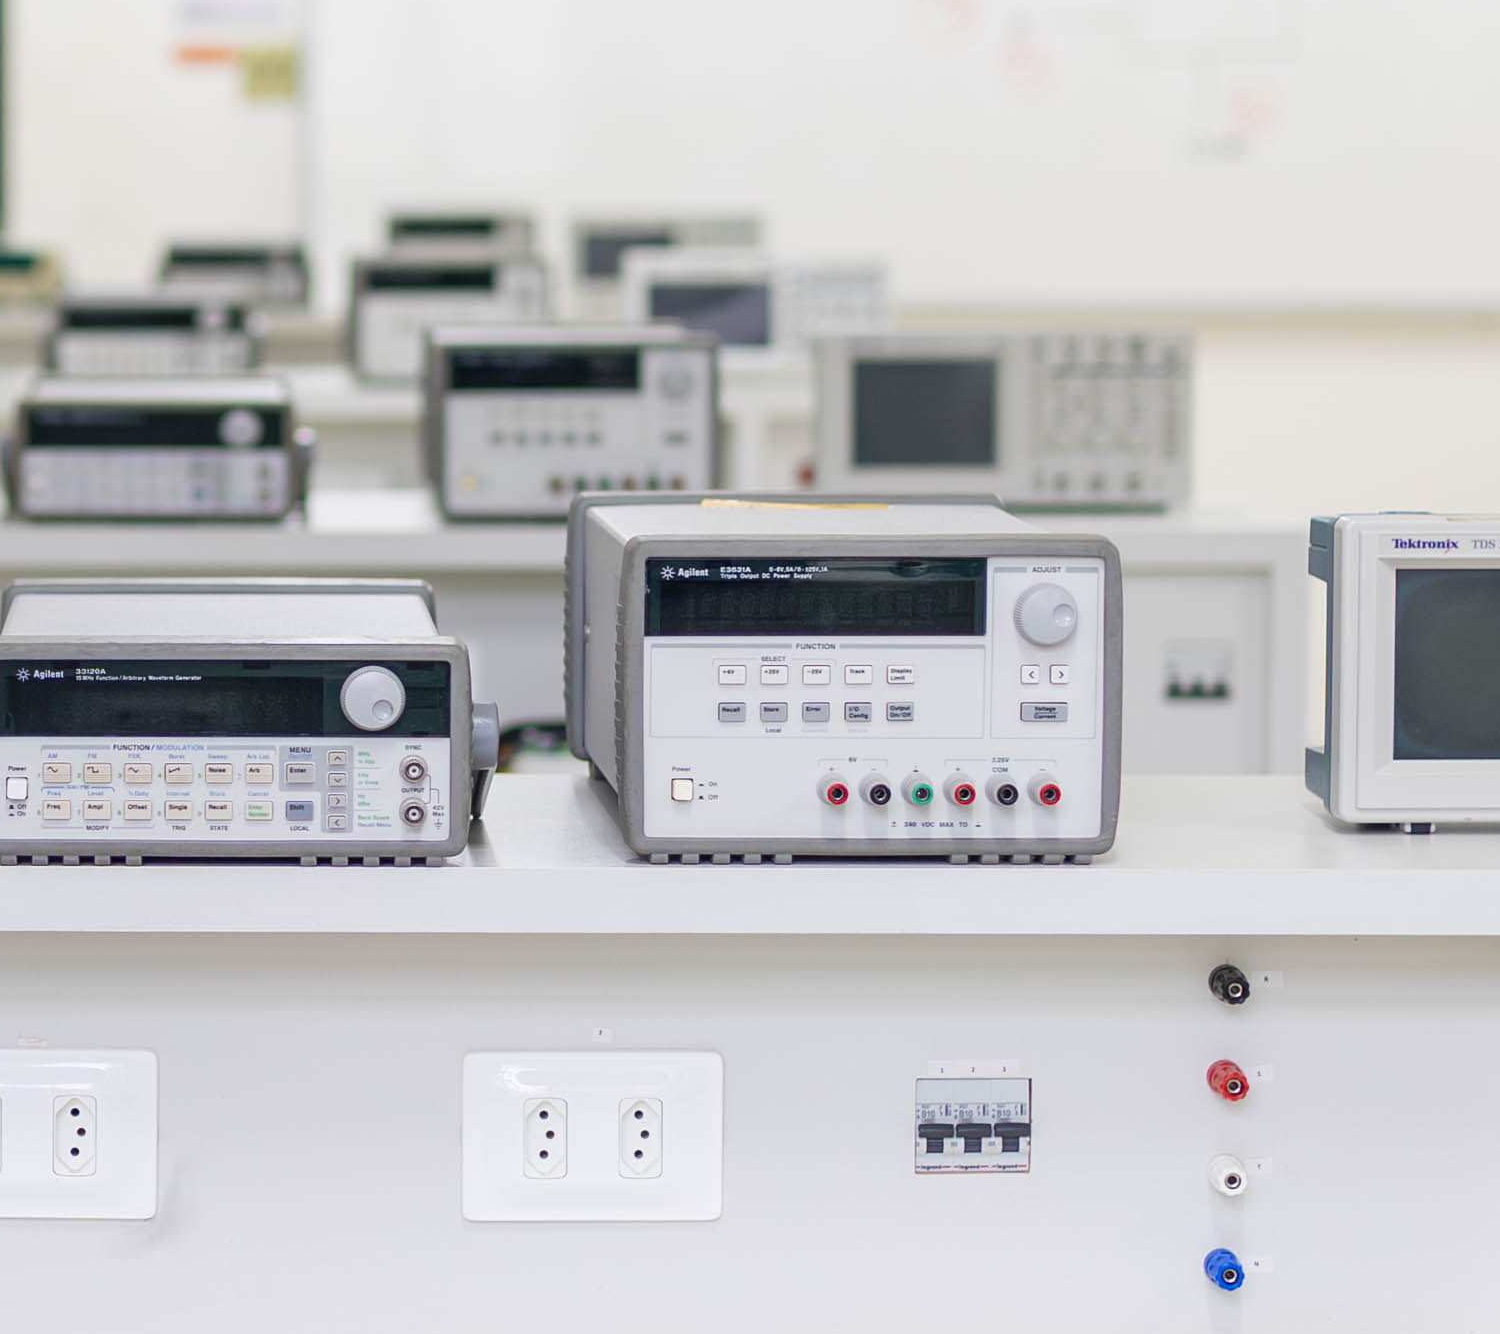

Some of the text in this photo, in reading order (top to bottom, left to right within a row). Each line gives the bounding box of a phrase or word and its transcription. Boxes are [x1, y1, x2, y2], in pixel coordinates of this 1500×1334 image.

[1391, 538, 1459, 551] Tektronix
[1471, 539, 1496, 549] TDS
[677, 567, 709, 578] Agilent
[33, 669, 64, 680] Agilent
[46, 803, 61, 811] Freq
[87, 803, 103, 811] Ampl
[168, 803, 188, 811] Single
